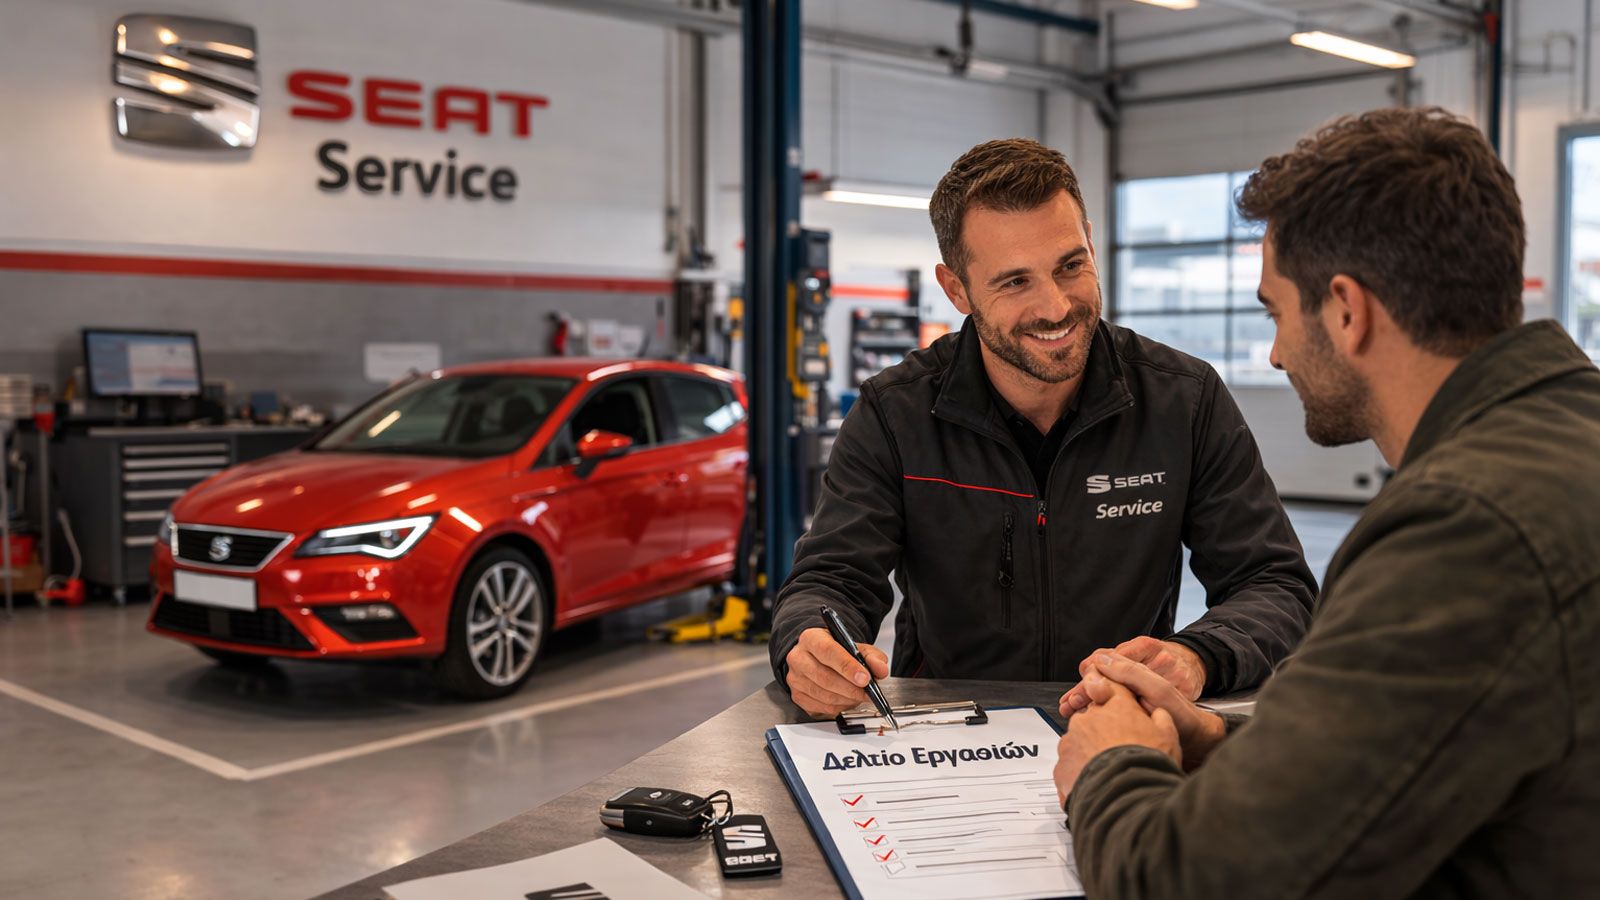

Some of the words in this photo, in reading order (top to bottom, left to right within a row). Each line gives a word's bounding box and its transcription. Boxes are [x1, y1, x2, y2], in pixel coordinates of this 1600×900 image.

[287, 71, 549, 137] SEAT
[317, 141, 518, 200] Service
[1114, 472, 1166, 488] SEAT
[1096, 499, 1163, 519] Service
[823, 749, 906, 771] Δελτίο
